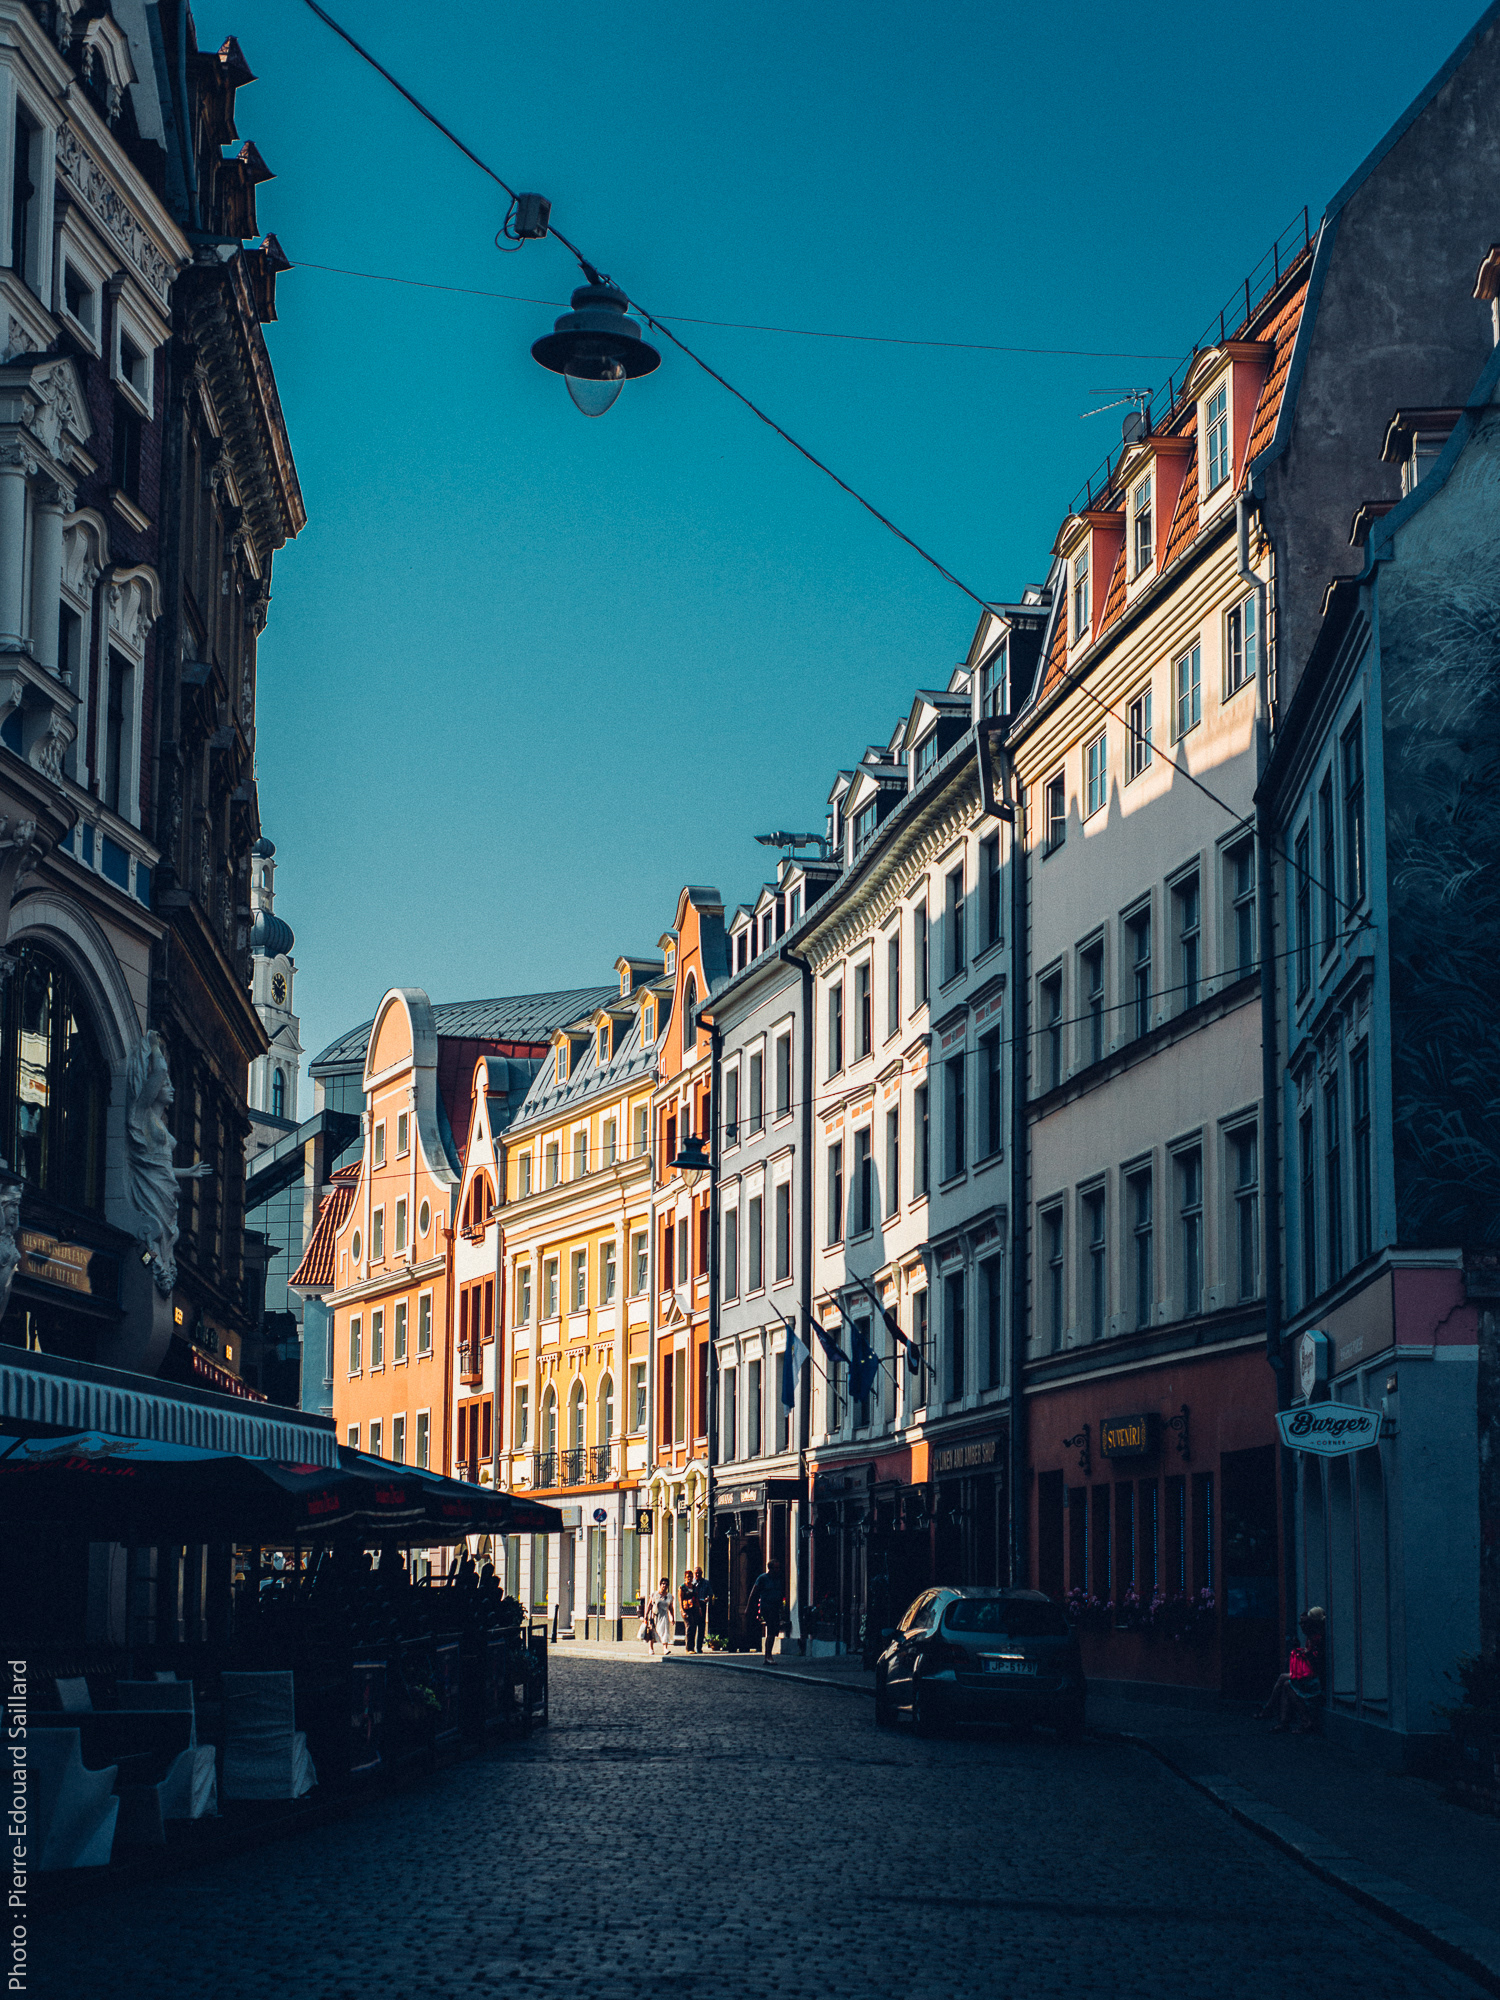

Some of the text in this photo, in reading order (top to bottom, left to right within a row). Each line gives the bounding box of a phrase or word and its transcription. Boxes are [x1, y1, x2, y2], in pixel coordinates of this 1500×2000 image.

[1108, 1425, 1140, 1448] SUVENĪRI
[1289, 1411, 1372, 1438] Burger
[953, 1447, 964, 1468] AND
[964, 1444, 981, 1466] AMBER
[982, 1441, 996, 1464] SHOP
